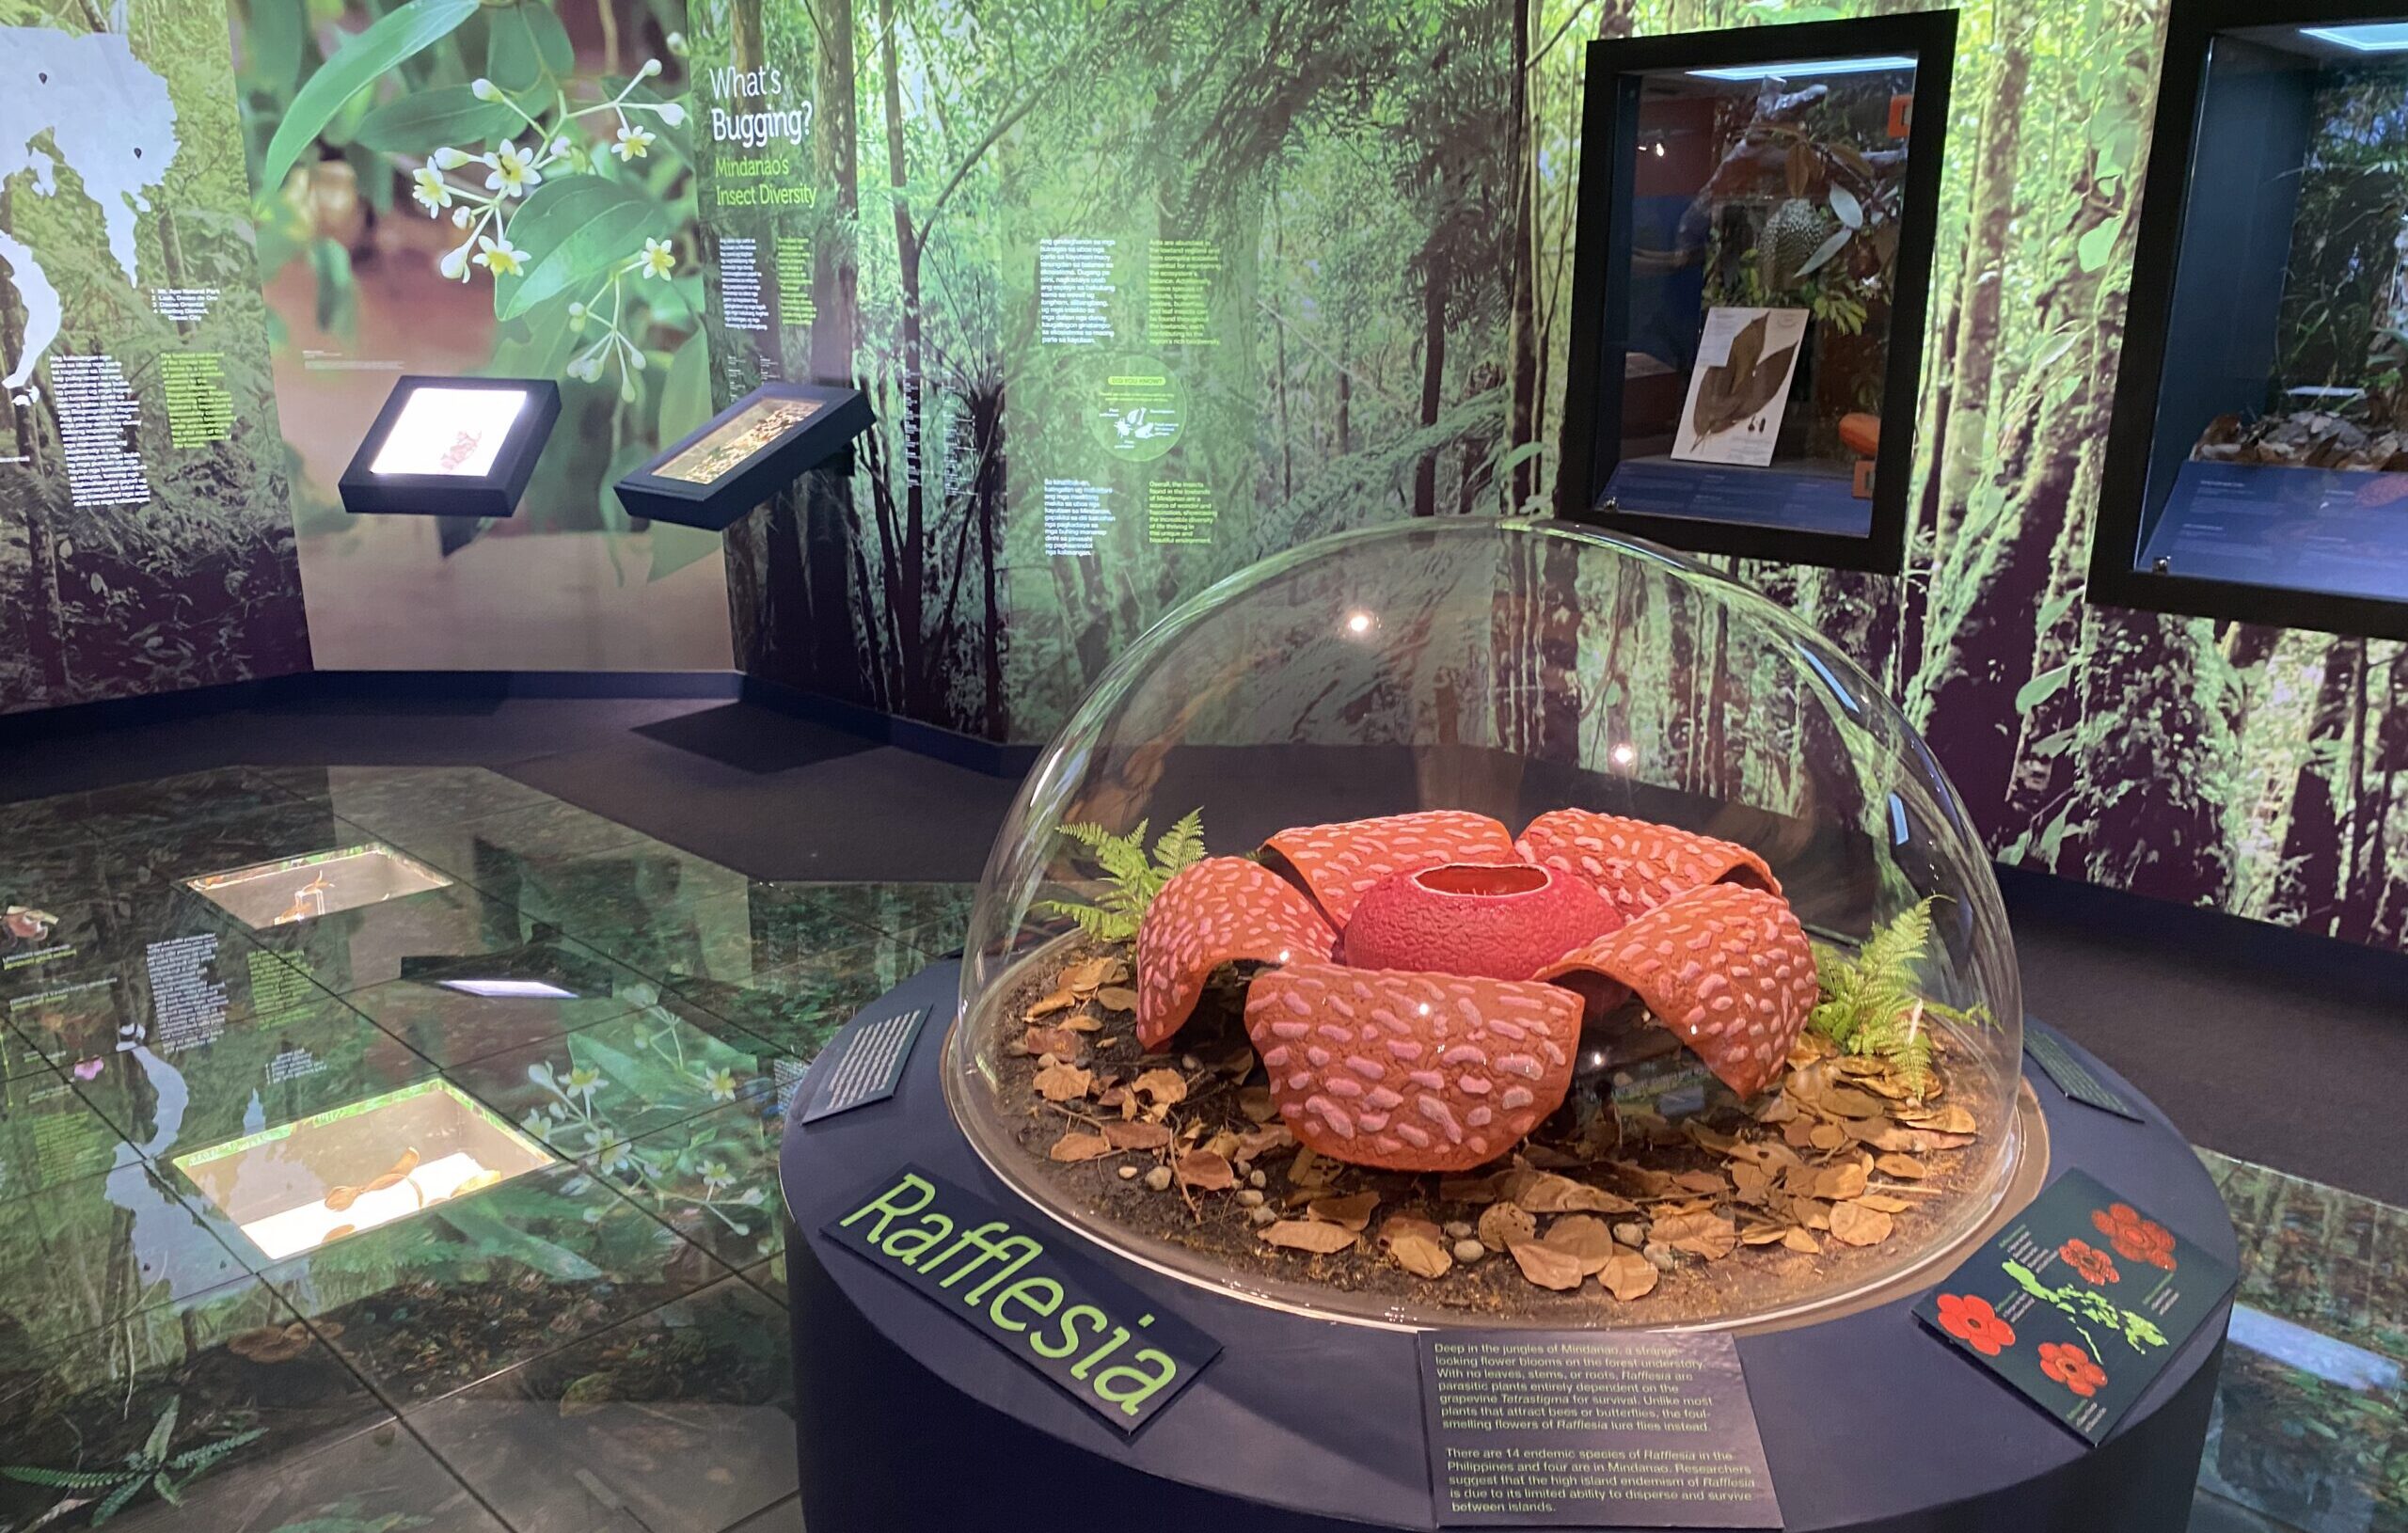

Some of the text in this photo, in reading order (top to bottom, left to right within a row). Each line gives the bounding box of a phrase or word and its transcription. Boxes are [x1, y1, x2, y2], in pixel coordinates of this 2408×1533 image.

[709, 62, 781, 100] What's
[711, 100, 813, 148] Bugging?
[715, 155, 789, 178] Mindanao's
[717, 182, 816, 209] Insect Diversity
[840, 1173, 1177, 1415] Rafflesia
[1434, 1343, 1465, 1354] Deep
[1468, 1344, 1478, 1353] in
[1481, 1344, 1499, 1353] the
[1503, 1344, 1544, 1355] jungles
[1547, 1344, 1558, 1353] of
[1435, 1357, 1477, 1367] looking
[1481, 1357, 1515, 1367] flower
[1519, 1357, 1561, 1367] blooms
[1583, 1358, 1601, 1367] the
[1606, 1358, 1637, 1368] forest
[1437, 1369, 1463, 1379] With
[1622, 1370, 1671, 1381] Rafflesia
[1438, 1382, 1488, 1392] parasitic
[1492, 1383, 1527, 1392] plants
[1531, 1383, 1572, 1393] entirely
[1576, 1383, 1639, 1395] dependent
[1660, 1384, 1678, 1393] the
[1440, 1395, 1497, 1405] grapevine
[1501, 1395, 1569, 1406] Tetrastigma
[1573, 1395, 1588, 1404] for
[1643, 1396, 1679, 1405] Unlike
[1684, 1398, 1711, 1406] most
[1442, 1407, 1478, 1417] plants
[1481, 1407, 1504, 1416] that
[1508, 1407, 1548, 1416] attract
[1549, 1408, 1577, 1417] bees
[1581, 1409, 1592, 1417] or
[1662, 1410, 1681, 1418] the
[1443, 1420, 1491, 1430] smelling
[1496, 1420, 1539, 1430] flowers
[1543, 1420, 1552, 1430] of
[1558, 1420, 1608, 1430] Rafflesia
[1637, 1422, 1660, 1430] flies
[1447, 1448, 1480, 1458] There
[1507, 1448, 1519, 1458] 14
[1524, 1448, 1575, 1459] endemic
[1579, 1450, 1625, 1461] species
[1629, 1449, 1640, 1459] of
[1644, 1449, 1694, 1461] Rafflesia
[1700, 1451, 1709, 1461] in
[1713, 1451, 1733, 1461] the
[1448, 1462, 1513, 1473] Philippines
[1517, 1462, 1540, 1472] and
[1544, 1462, 1567, 1472] four
[1594, 1462, 1604, 1472] in
[1675, 1463, 1751, 1474] Researchers
[1449, 1476, 1754, 1488] suggest that the high island endemism of Rafflesia
[1450, 1489, 1751, 1501] is due to its limited ability to disperse and survive
[1452, 1502, 1505, 1512] between
